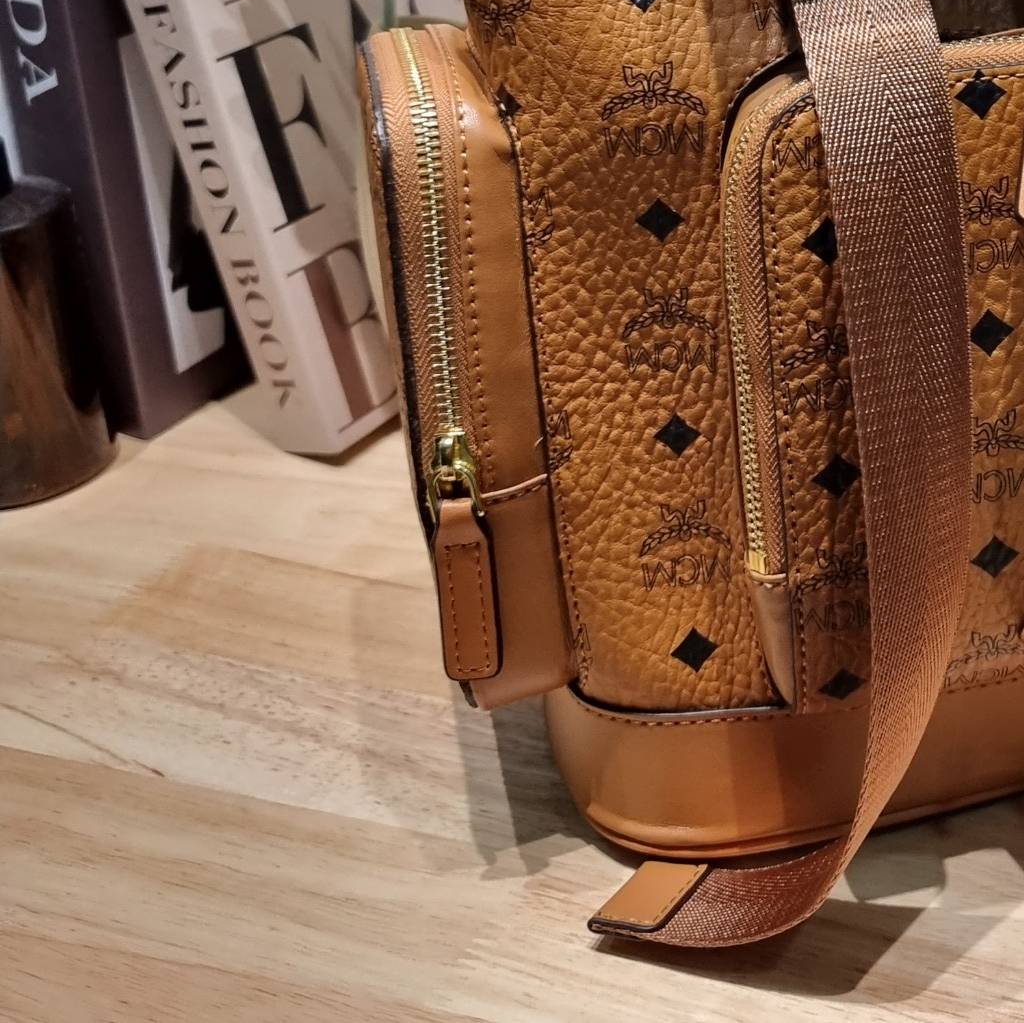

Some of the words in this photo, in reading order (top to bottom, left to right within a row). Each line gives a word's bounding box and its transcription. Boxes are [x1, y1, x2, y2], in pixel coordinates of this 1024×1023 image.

[604, 122, 704, 158] MCM
[143, 4, 247, 234] FASHION
[231, 259, 296, 409] BOOK
[624, 343, 717, 375] MCM
[784, 378, 849, 412] CM
[643, 559, 732, 592] MCM
